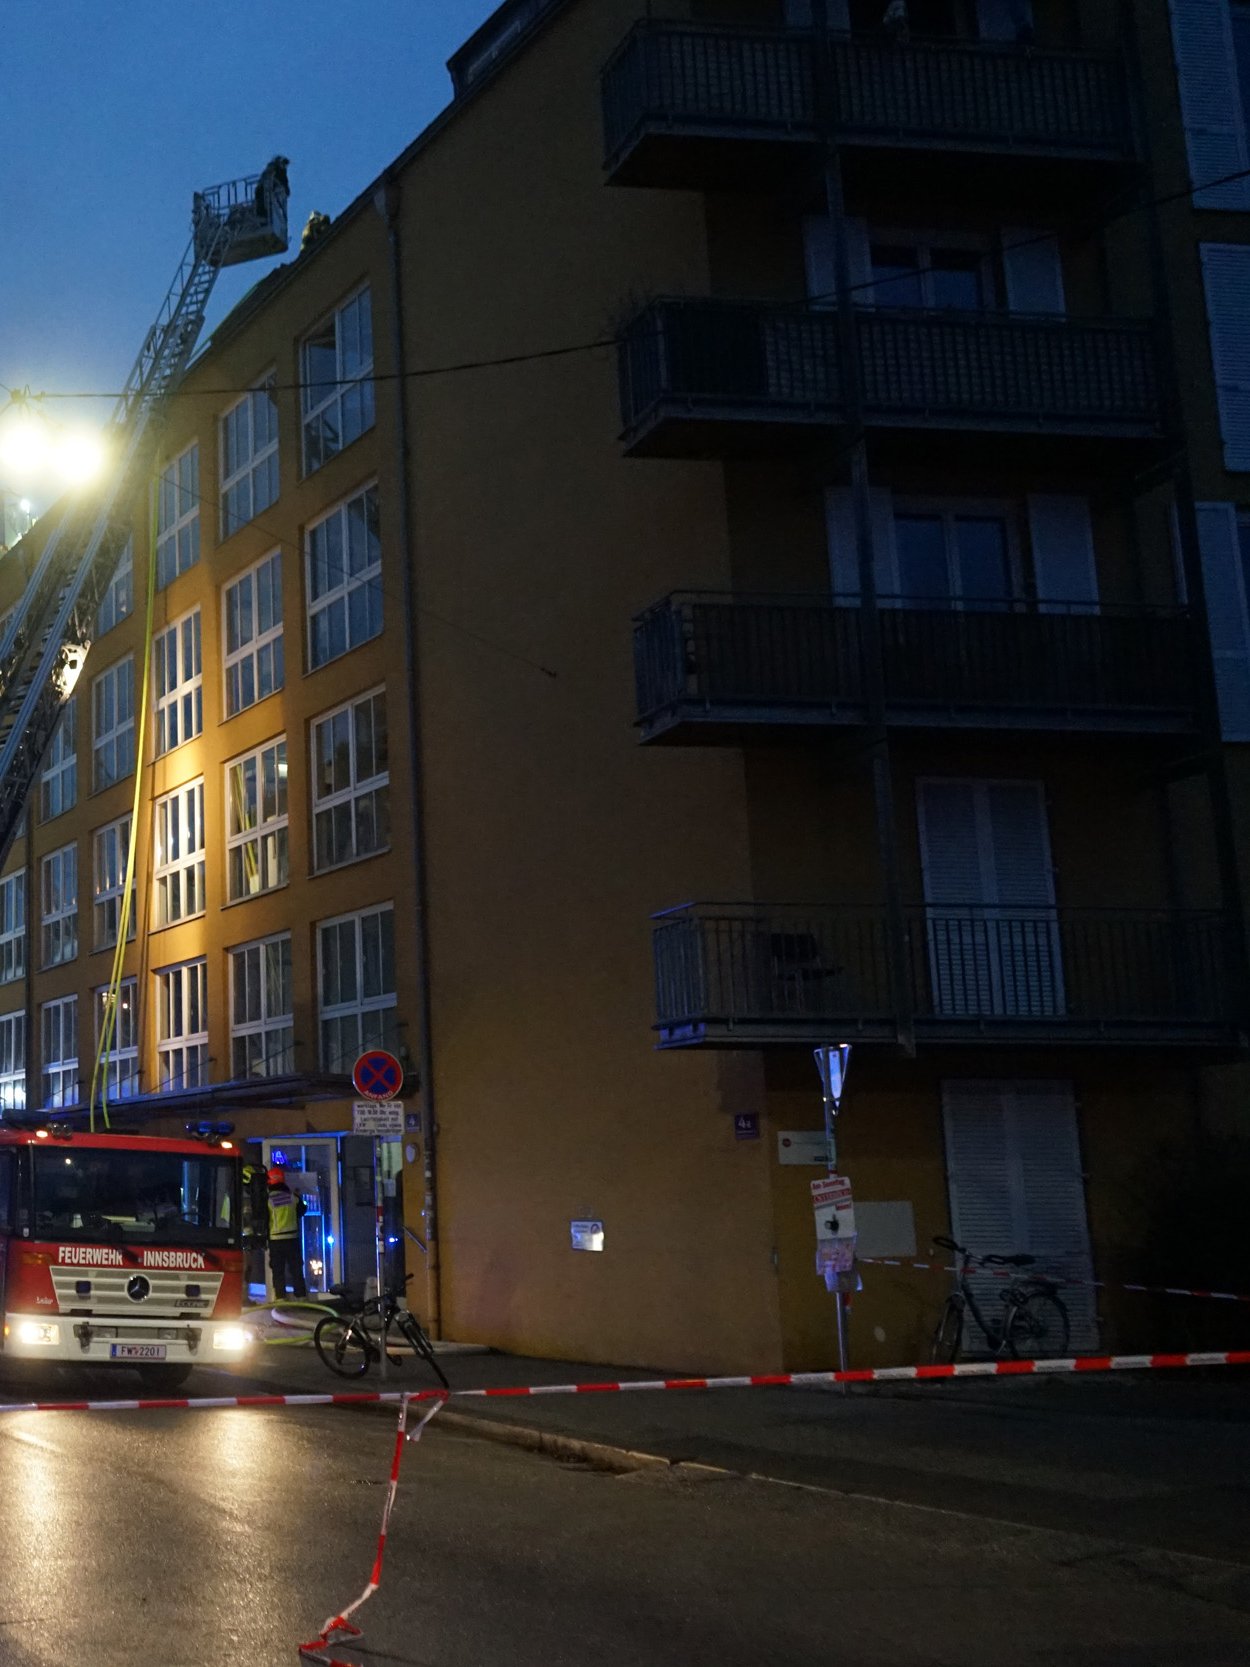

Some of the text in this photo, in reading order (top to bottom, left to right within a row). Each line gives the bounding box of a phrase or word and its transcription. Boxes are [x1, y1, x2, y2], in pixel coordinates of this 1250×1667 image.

[364, 1090, 393, 1100] ANFANG
[409, 1115, 416, 1126] 4
[738, 1116, 752, 1129] 4a
[58, 1246, 205, 1269] FEUERWEHR INNSBRUCK
[121, 1346, 160, 1356] FW 2201
